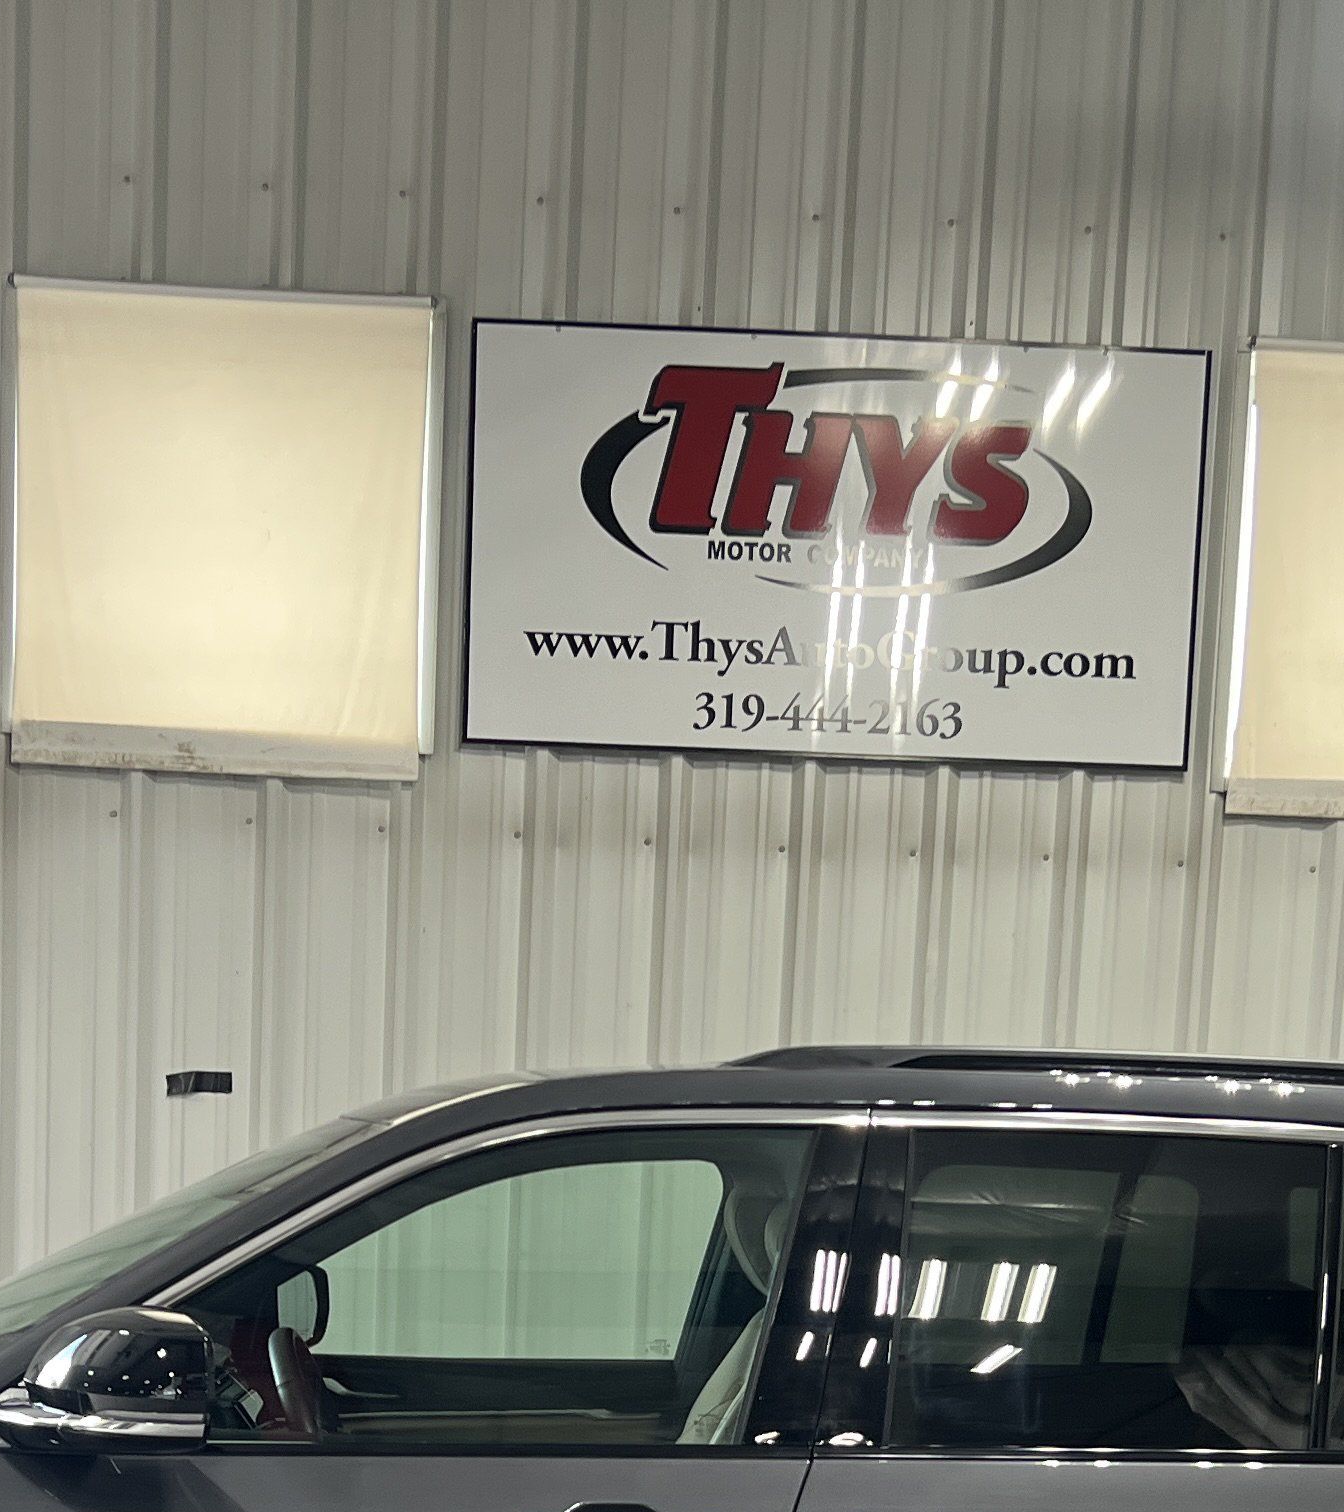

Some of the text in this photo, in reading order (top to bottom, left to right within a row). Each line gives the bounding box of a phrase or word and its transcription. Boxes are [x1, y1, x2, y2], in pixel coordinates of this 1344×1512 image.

[644, 362, 1034, 547] THYS
[707, 540, 792, 563] MOTOR
[692, 692, 963, 740] 319-444-2163
